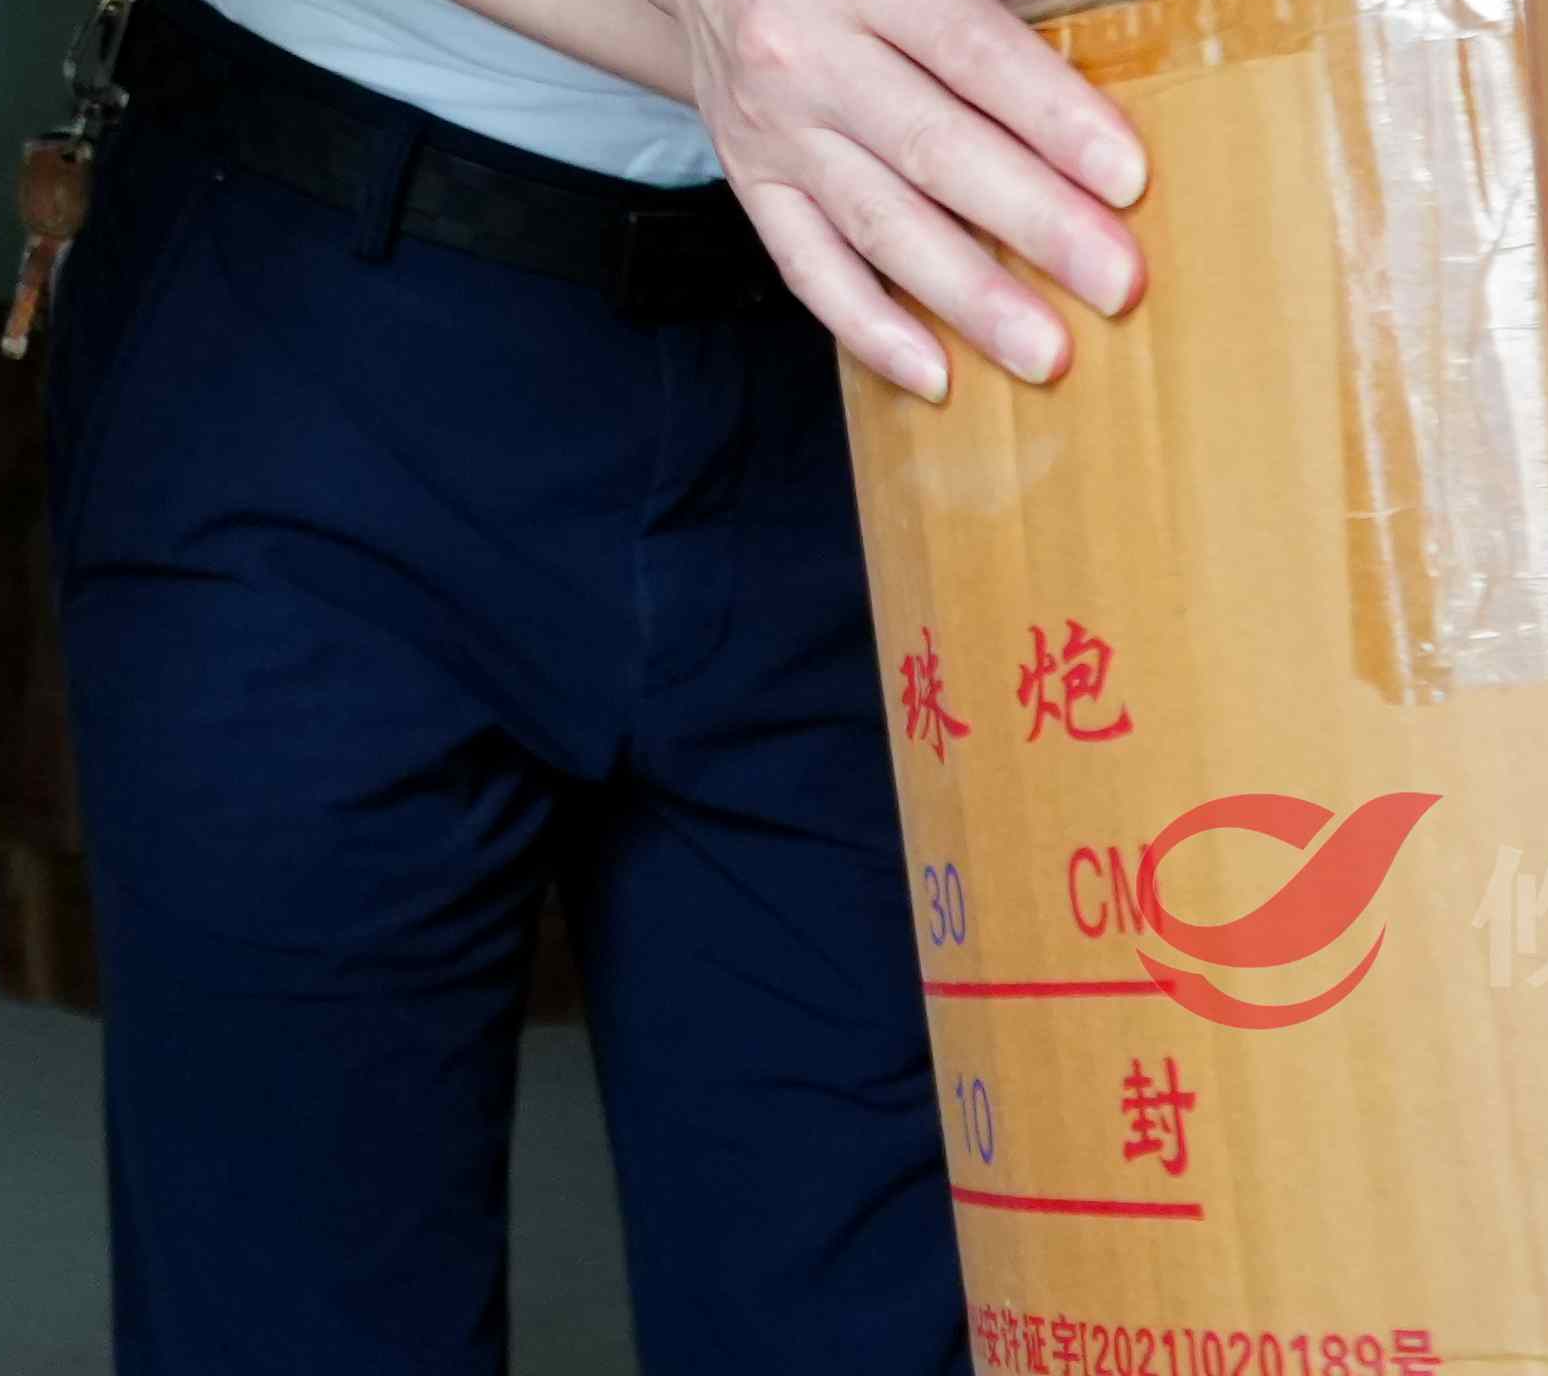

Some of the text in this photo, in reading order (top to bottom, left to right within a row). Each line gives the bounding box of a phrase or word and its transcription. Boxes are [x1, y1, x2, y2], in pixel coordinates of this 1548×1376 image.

[924, 862, 967, 950] 30
[955, 1056, 1198, 1178] 10 封
